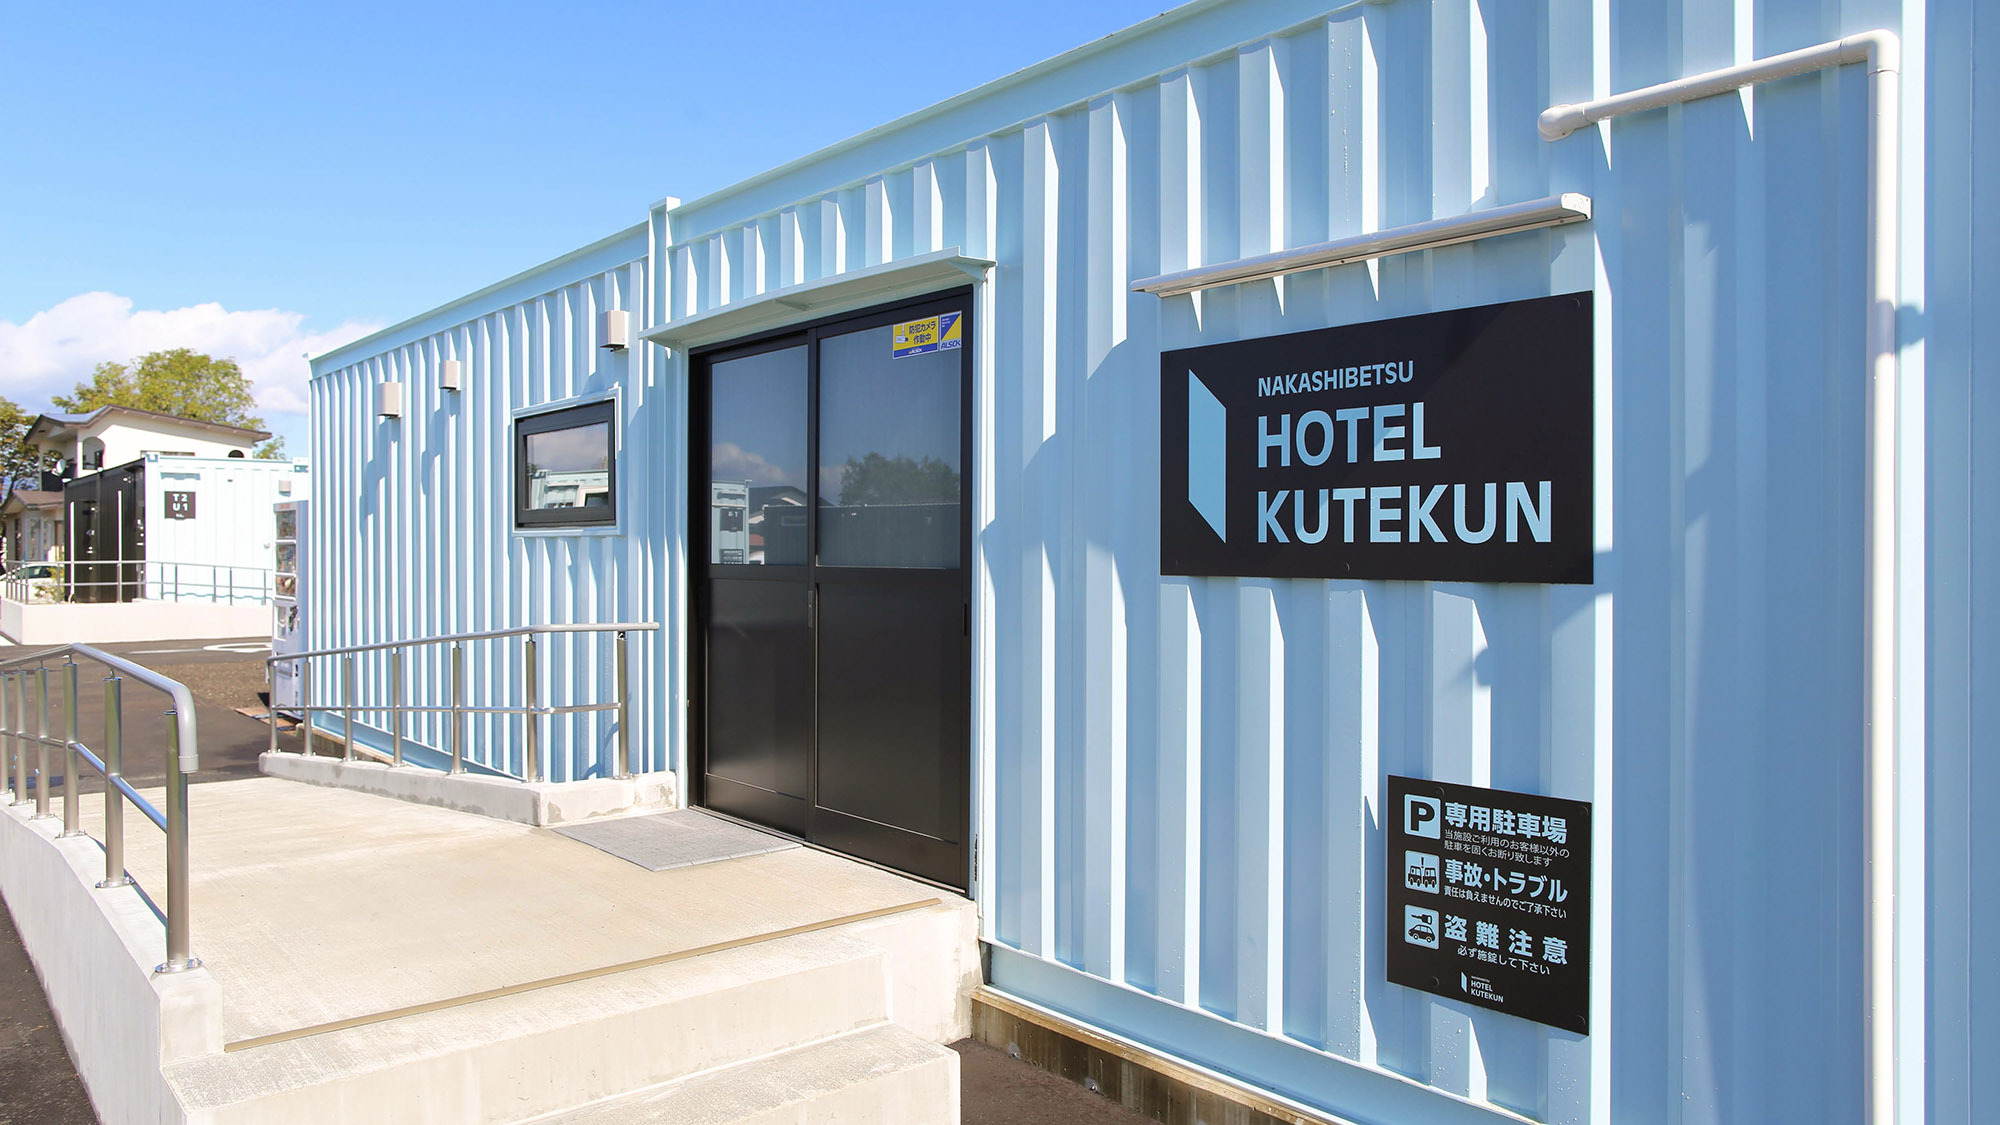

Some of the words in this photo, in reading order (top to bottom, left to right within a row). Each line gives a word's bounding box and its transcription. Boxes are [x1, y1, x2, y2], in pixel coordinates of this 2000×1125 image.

[914, 334, 931, 345] 作動中
[941, 340, 961, 350] ALSOK
[1258, 360, 1414, 397] NAKASHIBETSU
[1258, 402, 1442, 468] HOTEL
[1258, 480, 1552, 544] KUTEKUN
[1410, 800, 1435, 831] P
[1444, 802, 1567, 844] 専用駐車場
[1444, 829, 1570, 858] 当施設ご利用のお客様以外の
[1444, 840, 1552, 867] 駐車を固くお断り致します
[1444, 859, 1568, 903] 事故・トラブル
[1444, 885, 1567, 919] 責任は負えませんのでご了承下さい
[1444, 914, 1568, 965] 盗難注意
[1457, 945, 1550, 975] 必ず施錠して下さい
[1470, 980, 1493, 992] HOTEL
[1470, 988, 1504, 1003] KUTEKUN
